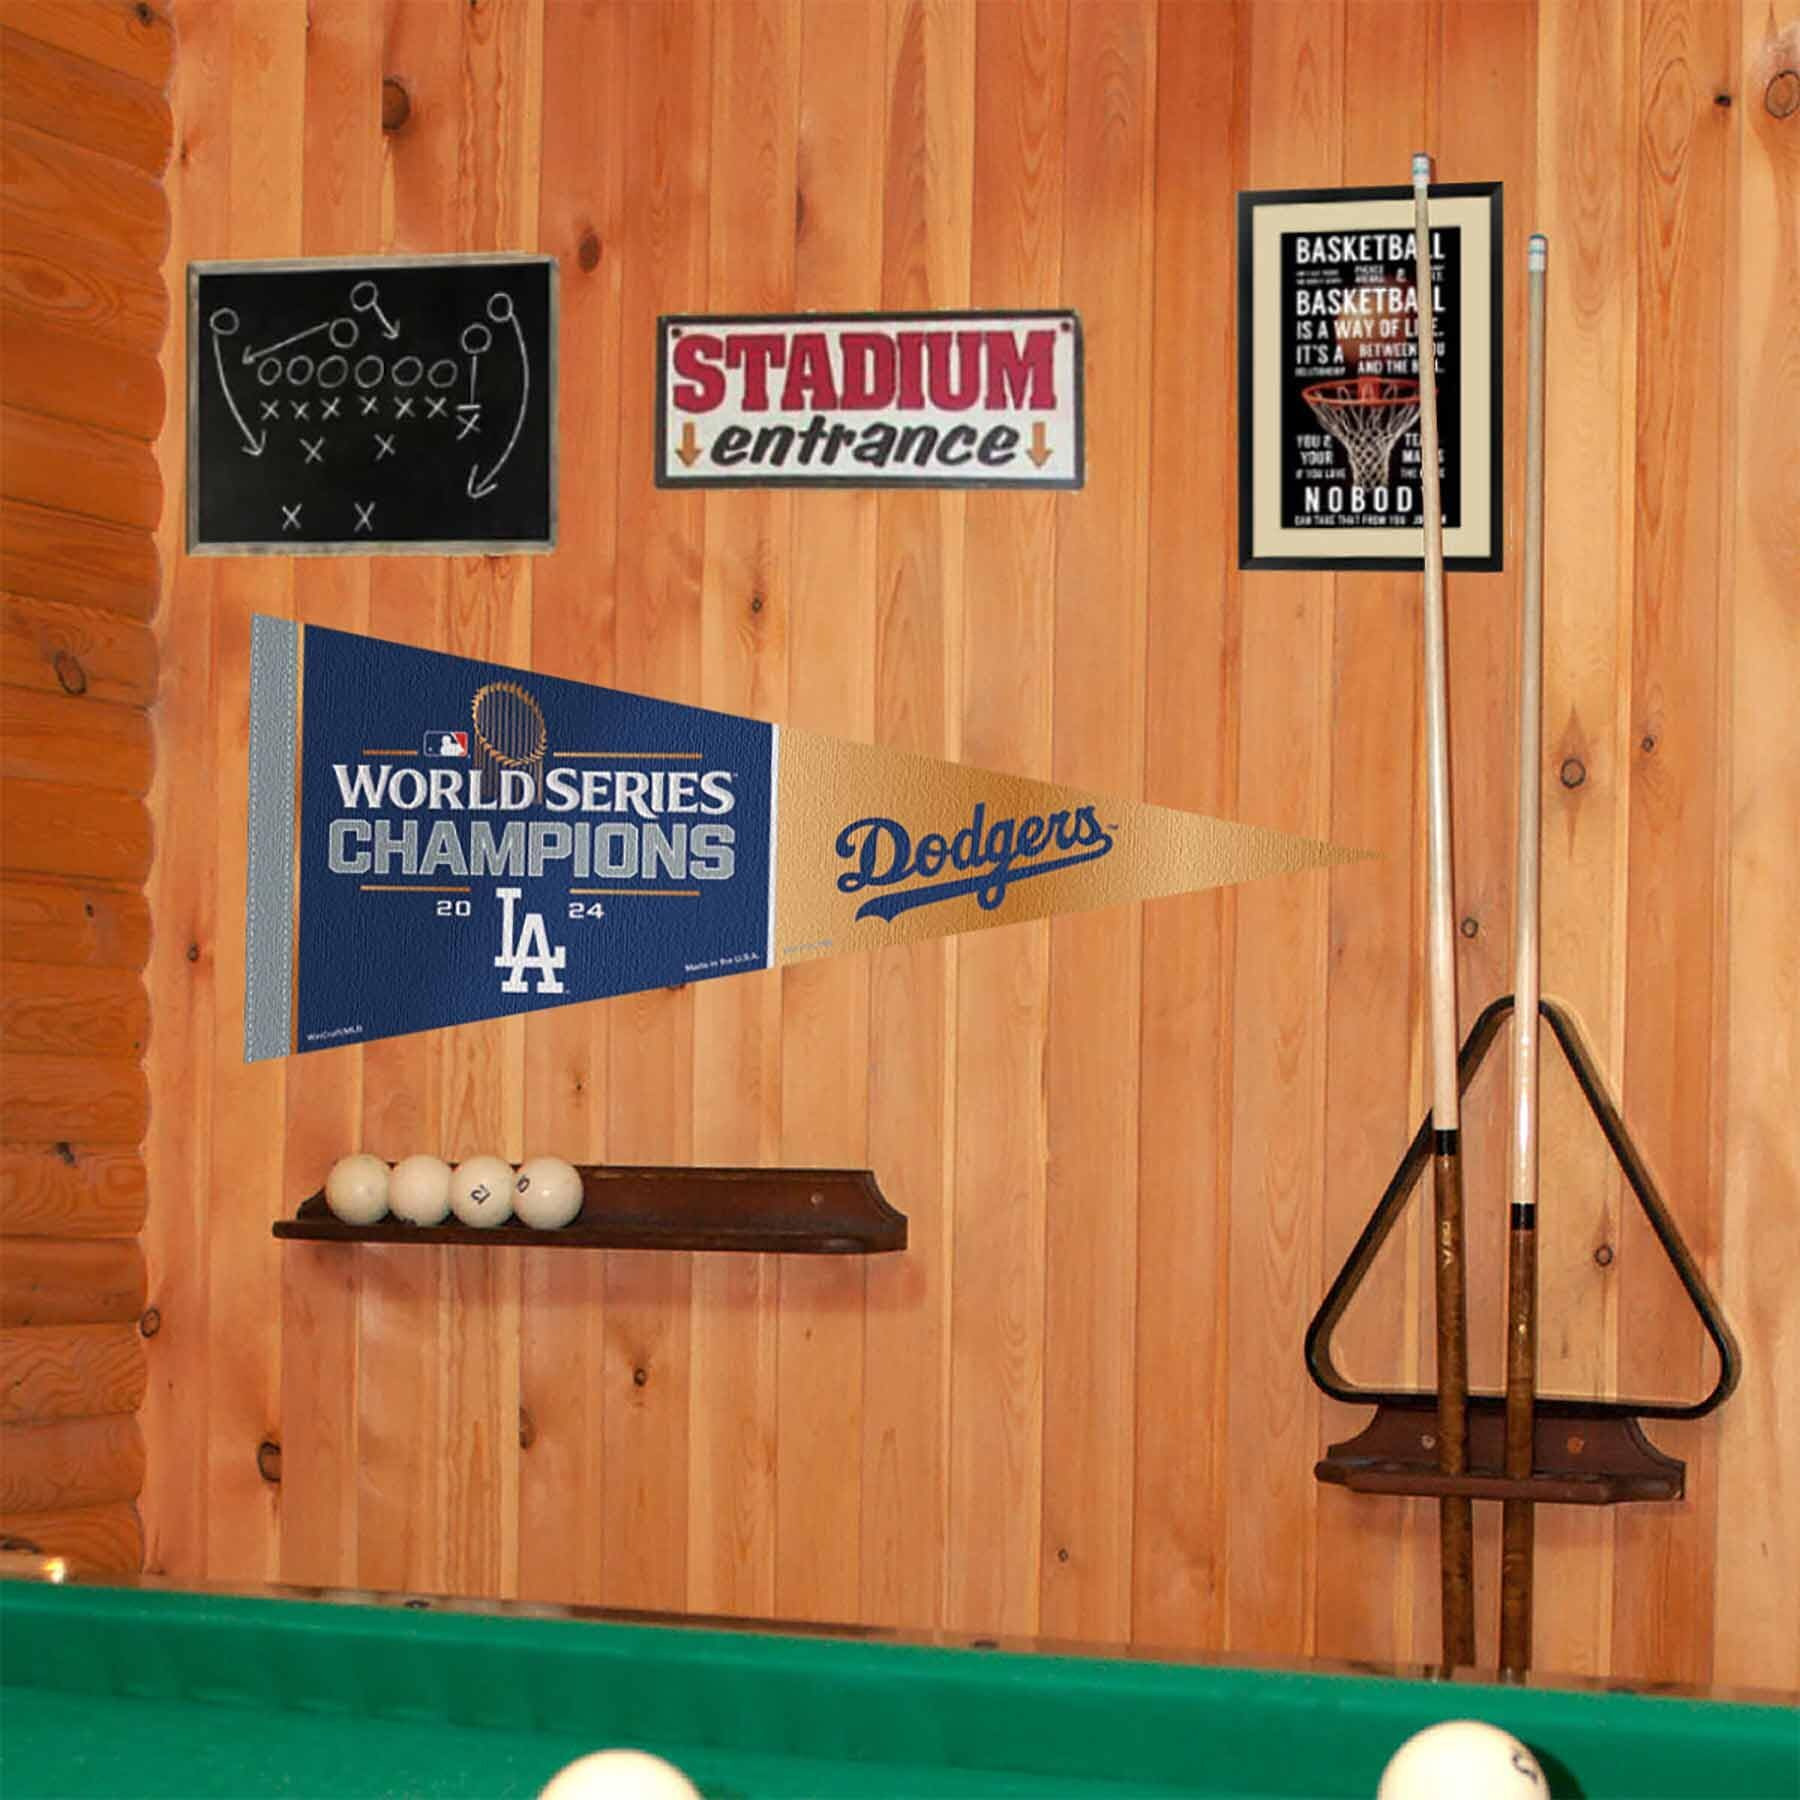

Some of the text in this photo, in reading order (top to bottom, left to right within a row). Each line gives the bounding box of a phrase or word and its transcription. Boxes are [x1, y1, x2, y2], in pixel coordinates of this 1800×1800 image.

[1296, 233, 1445, 264] BASKETBAL
[1296, 285, 1445, 316] BASKETBAL
[1296, 317, 1444, 340] IS A WAY OF LIE.
[1296, 345, 1328, 364] IT'S
[1333, 344, 1344, 364] A
[1357, 359, 1383, 374] AND
[1386, 359, 1408, 374] THE
[672, 329, 1057, 413] STADIUM
[710, 414, 1020, 468] entrance
[1296, 434, 1321, 449] YOU
[1301, 451, 1333, 465] YOUR
[1305, 486, 1424, 513] NOBOD
[333, 763, 736, 820] WORLD SERIES
[328, 819, 737, 880] CHAMPIONS
[835, 802, 1113, 923] Dodgers
[436, 900, 605, 919] 20 24
[494, 887, 566, 994] LA
[720, 957, 733, 967] the
